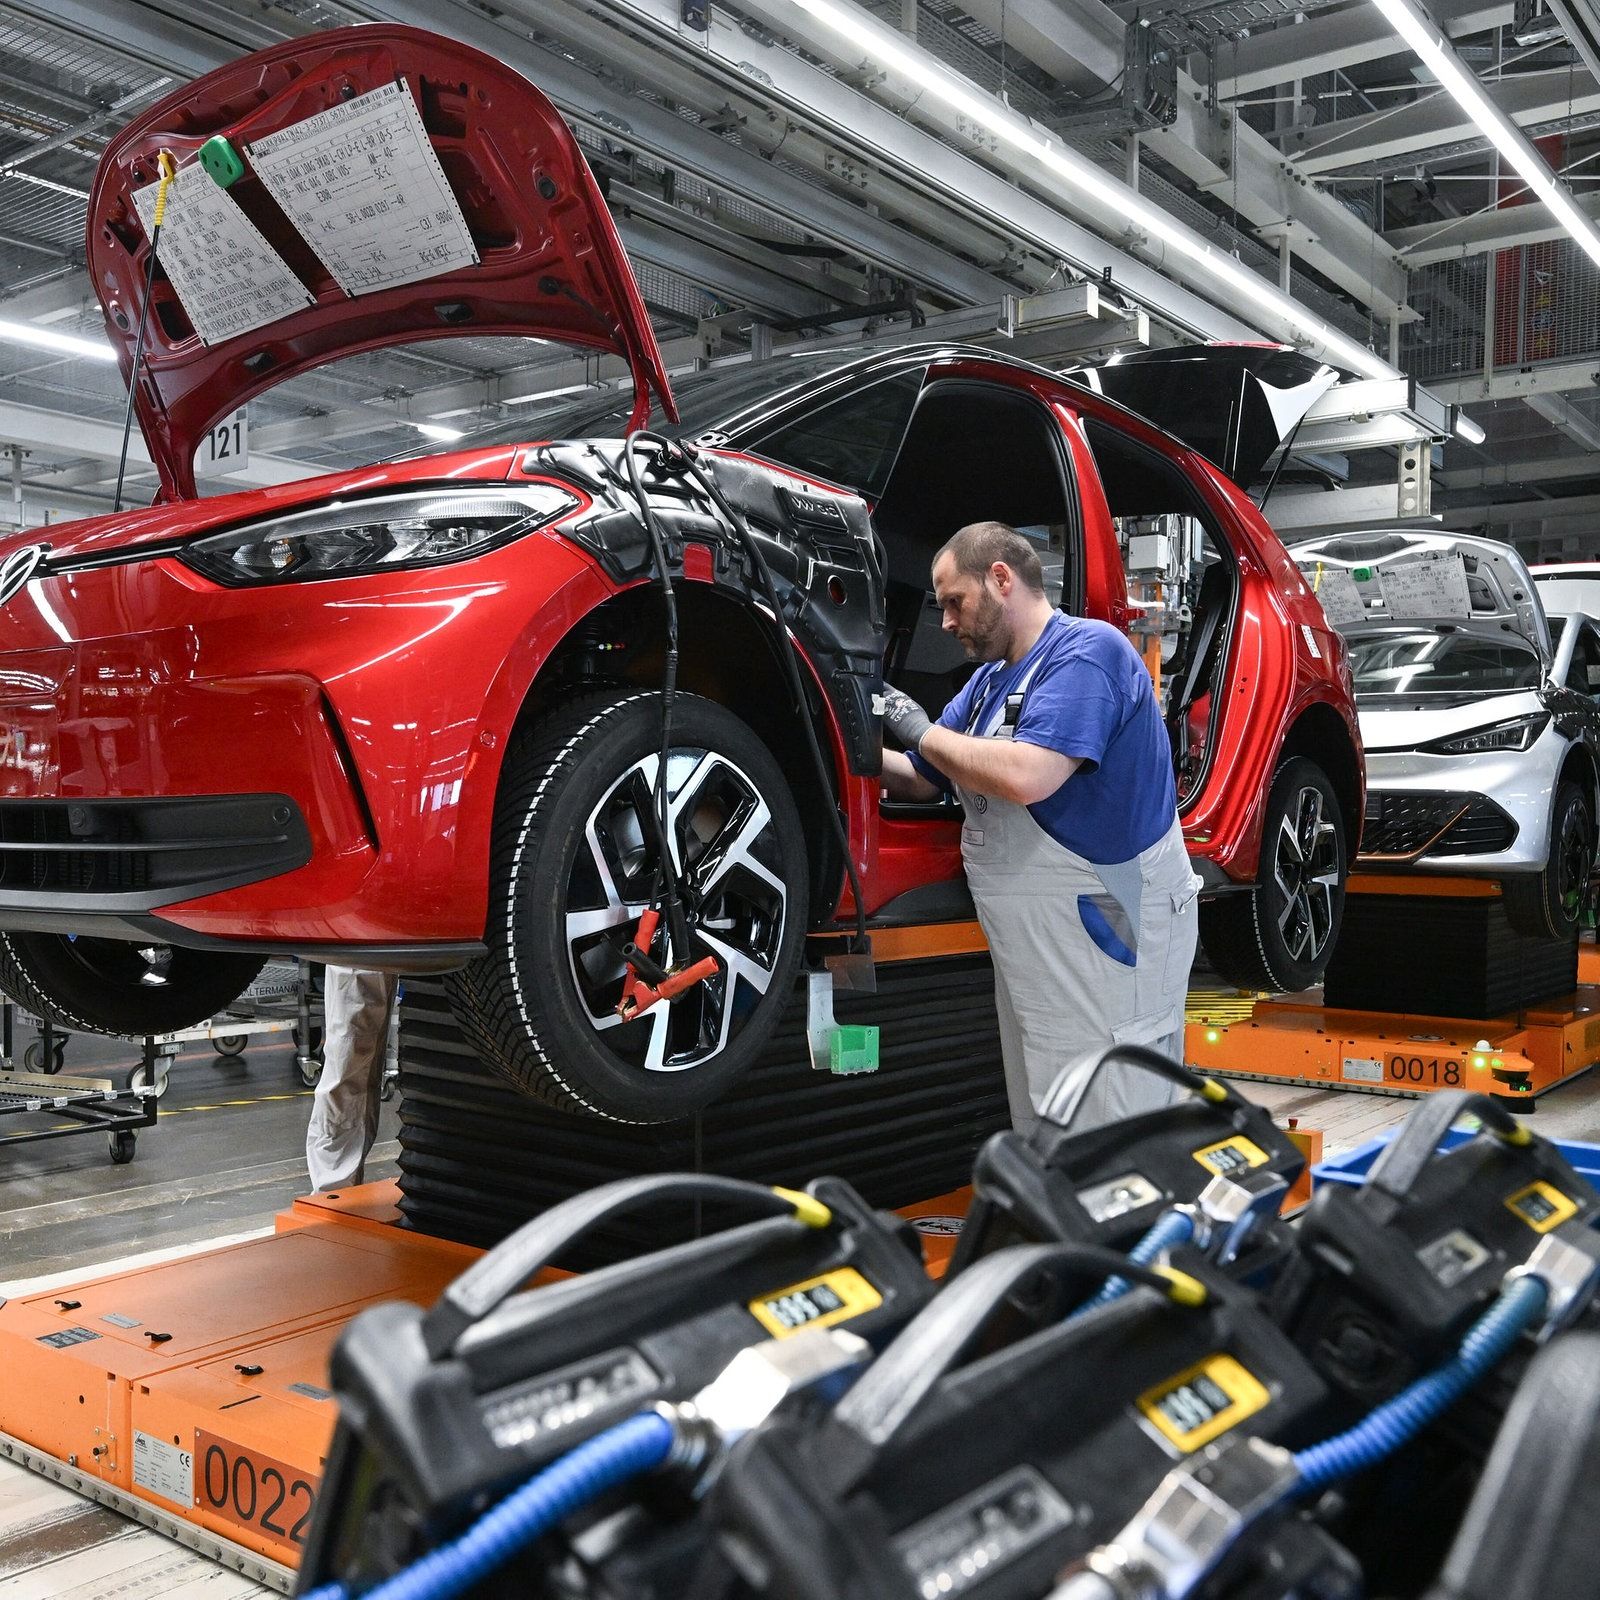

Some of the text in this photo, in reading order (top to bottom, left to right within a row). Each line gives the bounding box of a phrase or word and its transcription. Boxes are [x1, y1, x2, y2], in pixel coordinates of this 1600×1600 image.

[208, 422, 240, 461] 121
[1391, 1056, 1460, 1085] 0018
[205, 1444, 315, 1543] 0022
